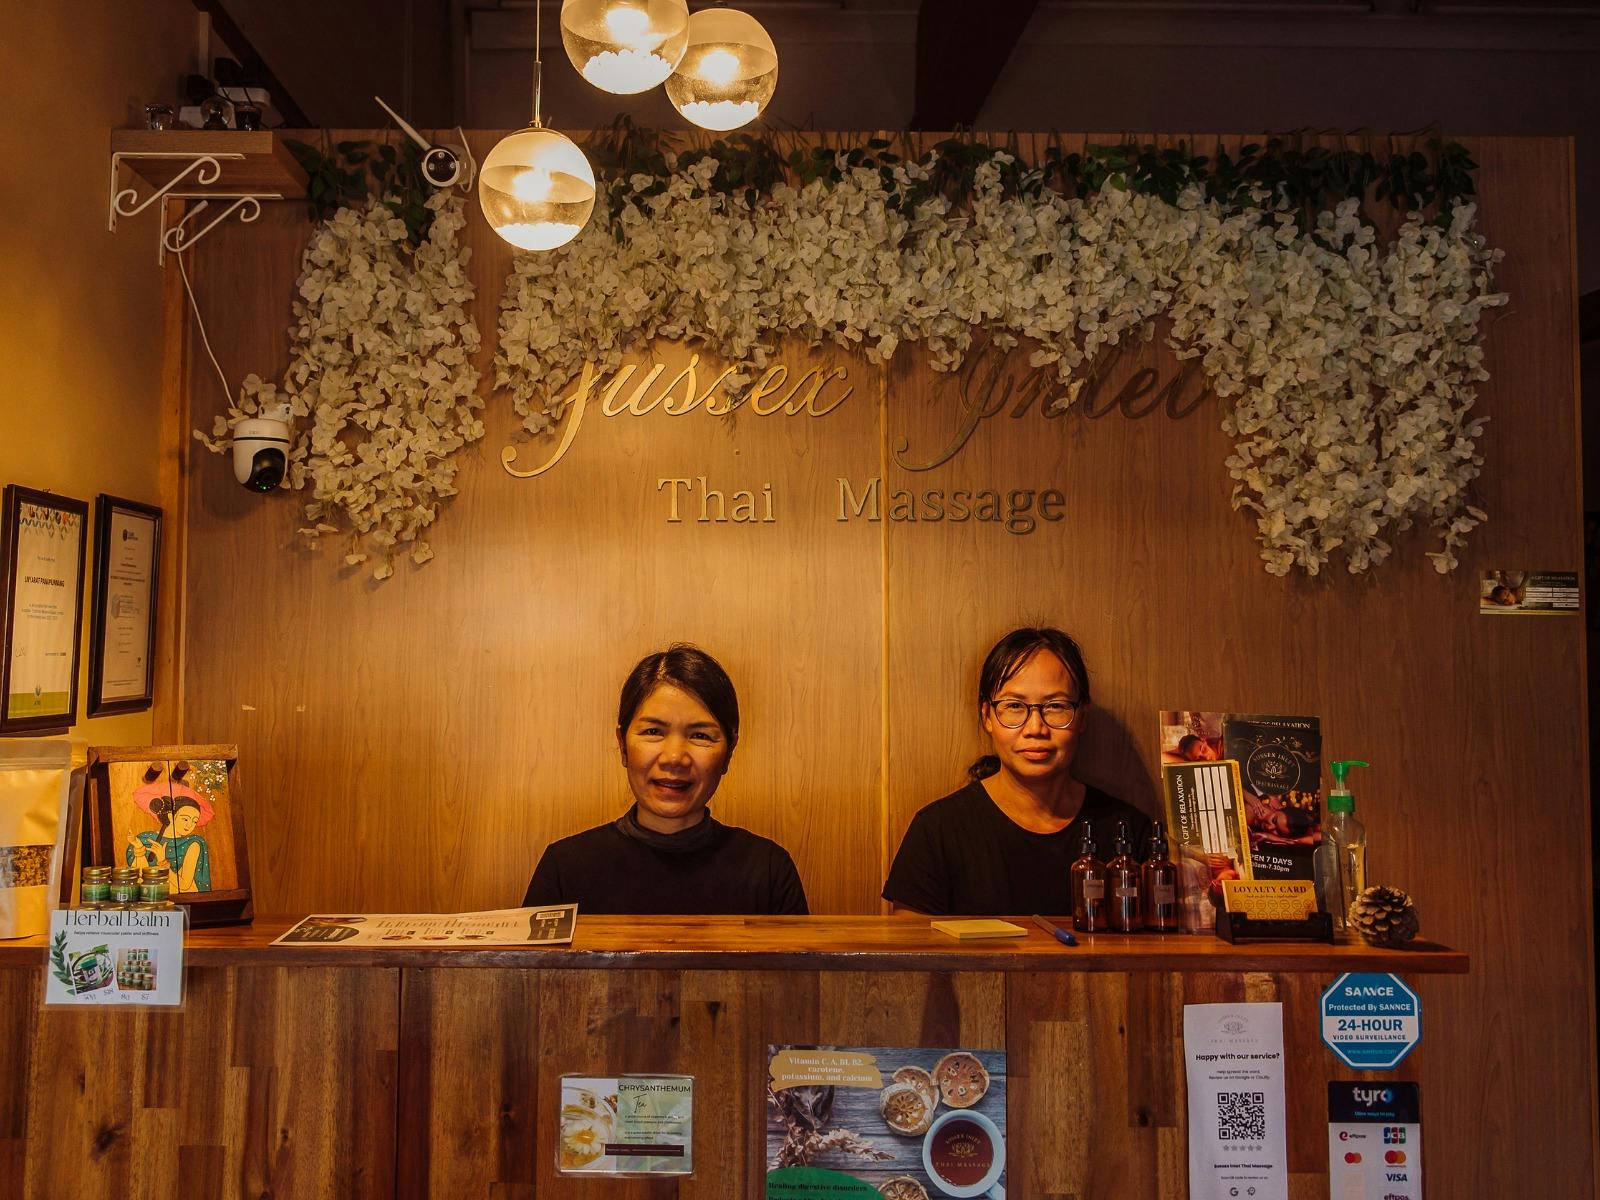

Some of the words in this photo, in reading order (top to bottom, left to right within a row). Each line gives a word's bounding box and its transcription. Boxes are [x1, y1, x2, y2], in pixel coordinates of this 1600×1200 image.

[656, 476, 776, 523] Thai
[835, 477, 1066, 536] Massage
[1176, 774, 1187, 814] RELAXATION
[1180, 815, 1188, 824] OF
[1182, 826, 1190, 840] GIFT
[1272, 857, 1293, 866] DAYS
[1233, 885, 1277, 894] LOYALTY
[1280, 885, 1307, 894] CARD
[66, 910, 123, 926] Herbal
[127, 911, 170, 927] Balm
[1328, 1003, 1366, 1011] Protected
[1367, 1003, 1377, 1012] By
[1379, 1003, 1411, 1011] SANNCE
[1338, 1019, 1403, 1031] 24-HOUR
[788, 1057, 820, 1065] Vitamin
[1195, 1054, 1219, 1062] Happy
[1219, 1052, 1236, 1060] with
[1250, 1052, 1280, 1060] service?
[618, 1084, 691, 1093] CHRYSANTHEMUM
[1352, 1086, 1393, 1107] tyro
[633, 1093, 648, 1114] Tea
[1385, 1173, 1408, 1182] VISA
[768, 1182, 797, 1191] Healing
[798, 1183, 831, 1192] digestive
[832, 1184, 868, 1192] disorders
